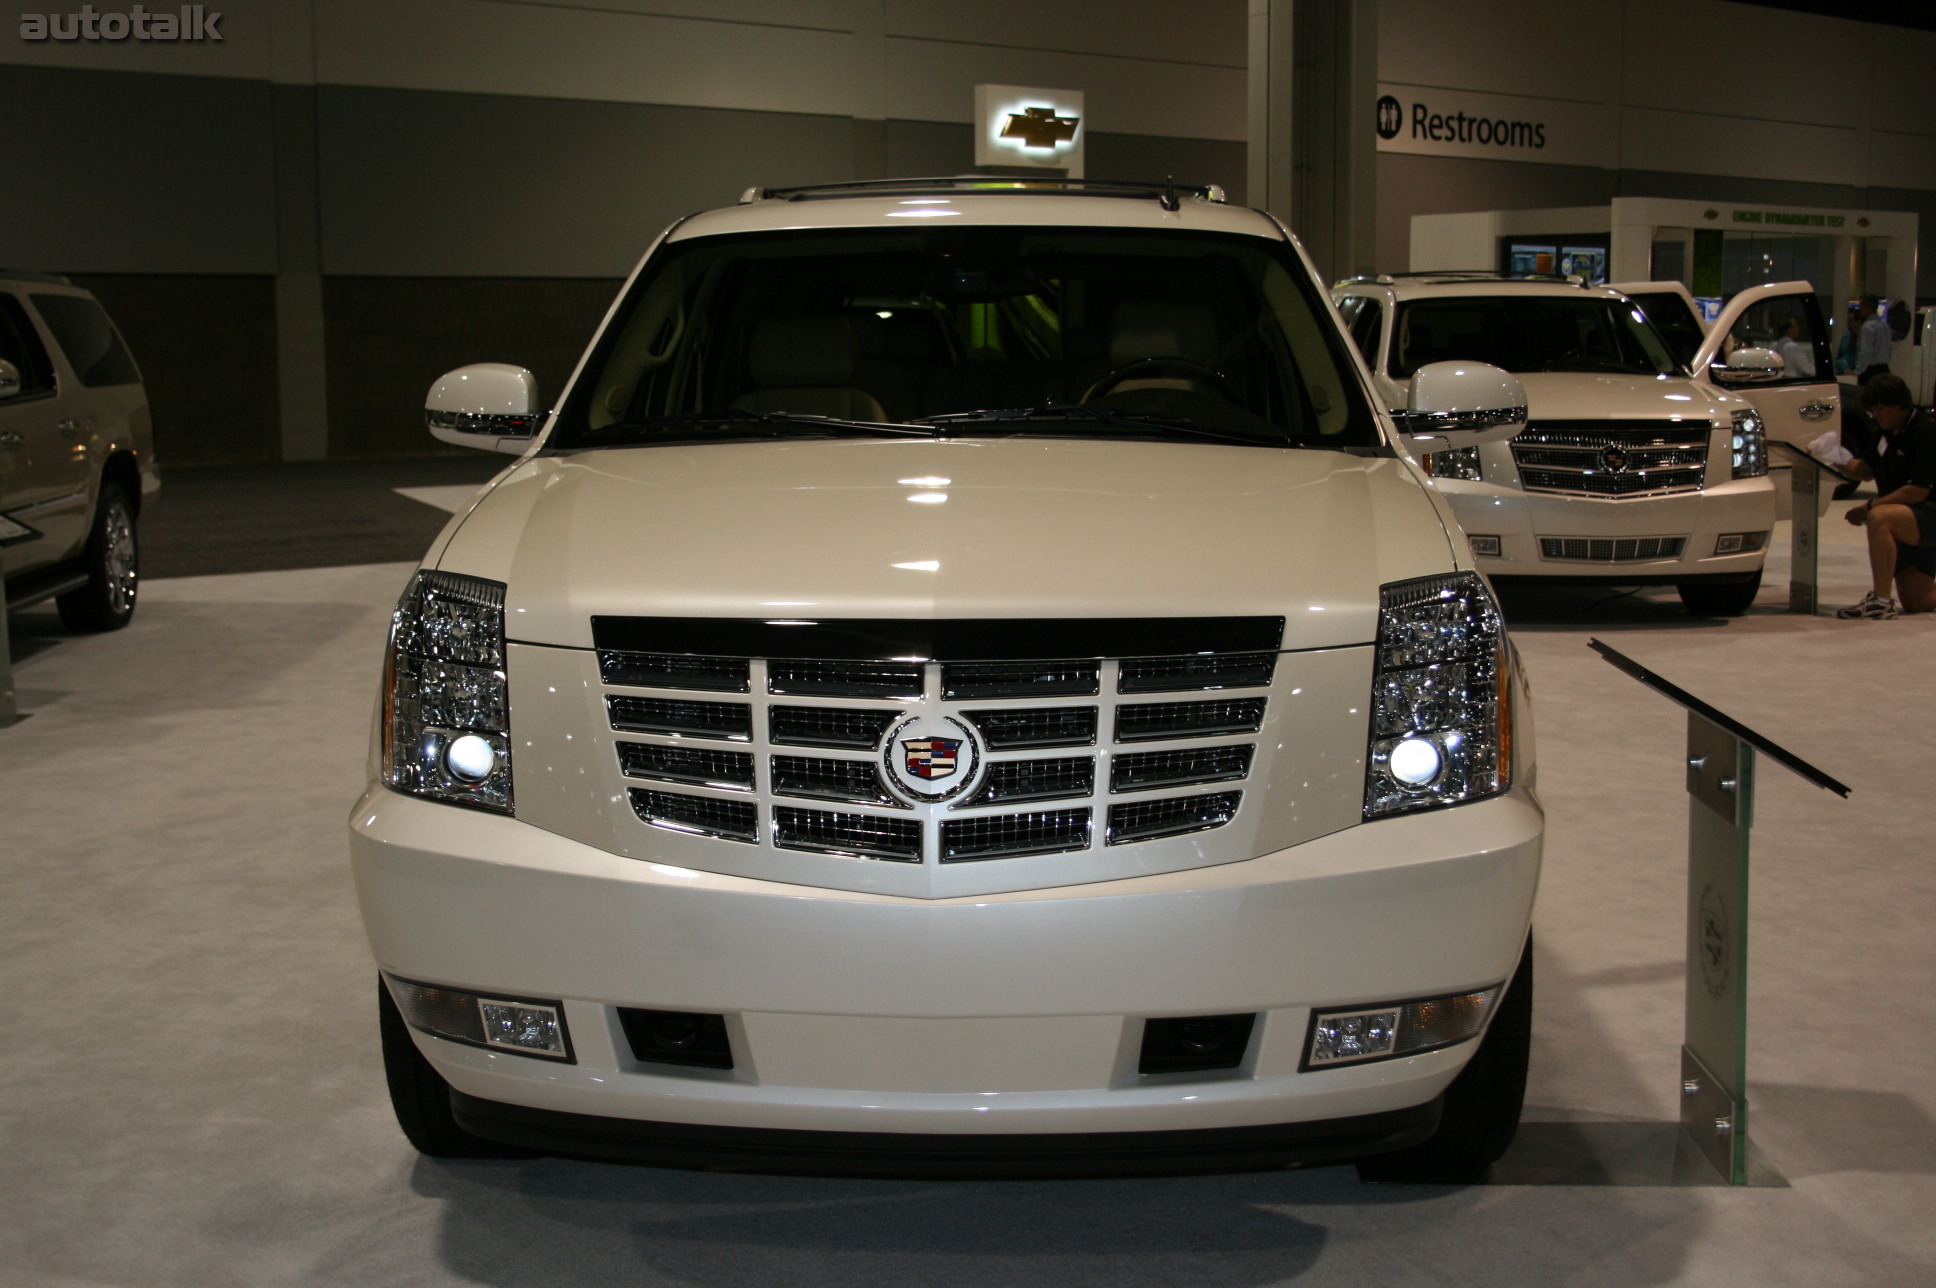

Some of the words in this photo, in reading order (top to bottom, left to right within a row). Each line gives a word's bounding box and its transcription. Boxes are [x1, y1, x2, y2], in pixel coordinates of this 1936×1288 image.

[1411, 102, 1546, 149] Restrooms
[1733, 210, 1763, 223] ENGINE
[1827, 215, 1846, 227] TEST
